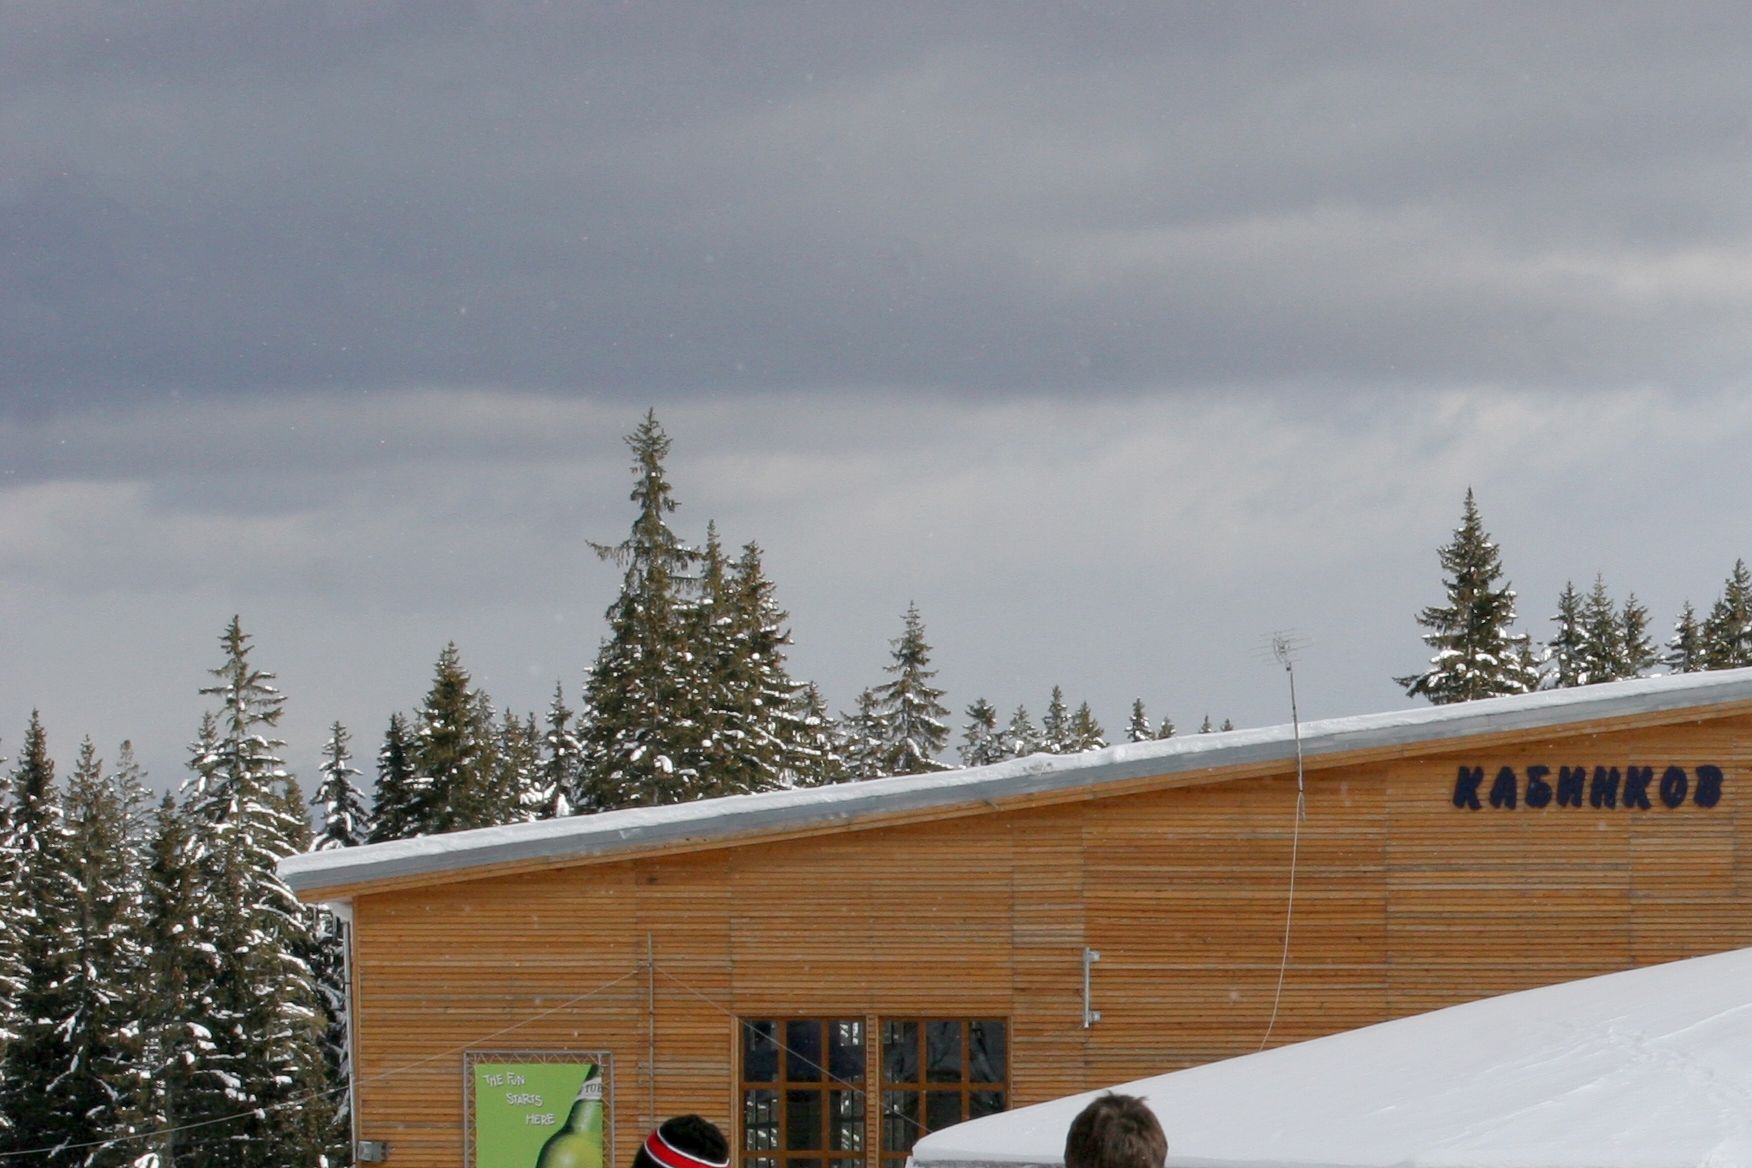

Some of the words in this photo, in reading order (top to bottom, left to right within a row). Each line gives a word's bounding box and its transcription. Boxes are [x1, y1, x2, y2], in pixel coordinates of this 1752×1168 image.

[1452, 765, 1724, 811] КАБИНКОВ
[482, 1074, 504, 1087] THE
[507, 1072, 525, 1087] FUN
[506, 1092, 543, 1107] STARTS
[526, 1113, 556, 1126] HERE
